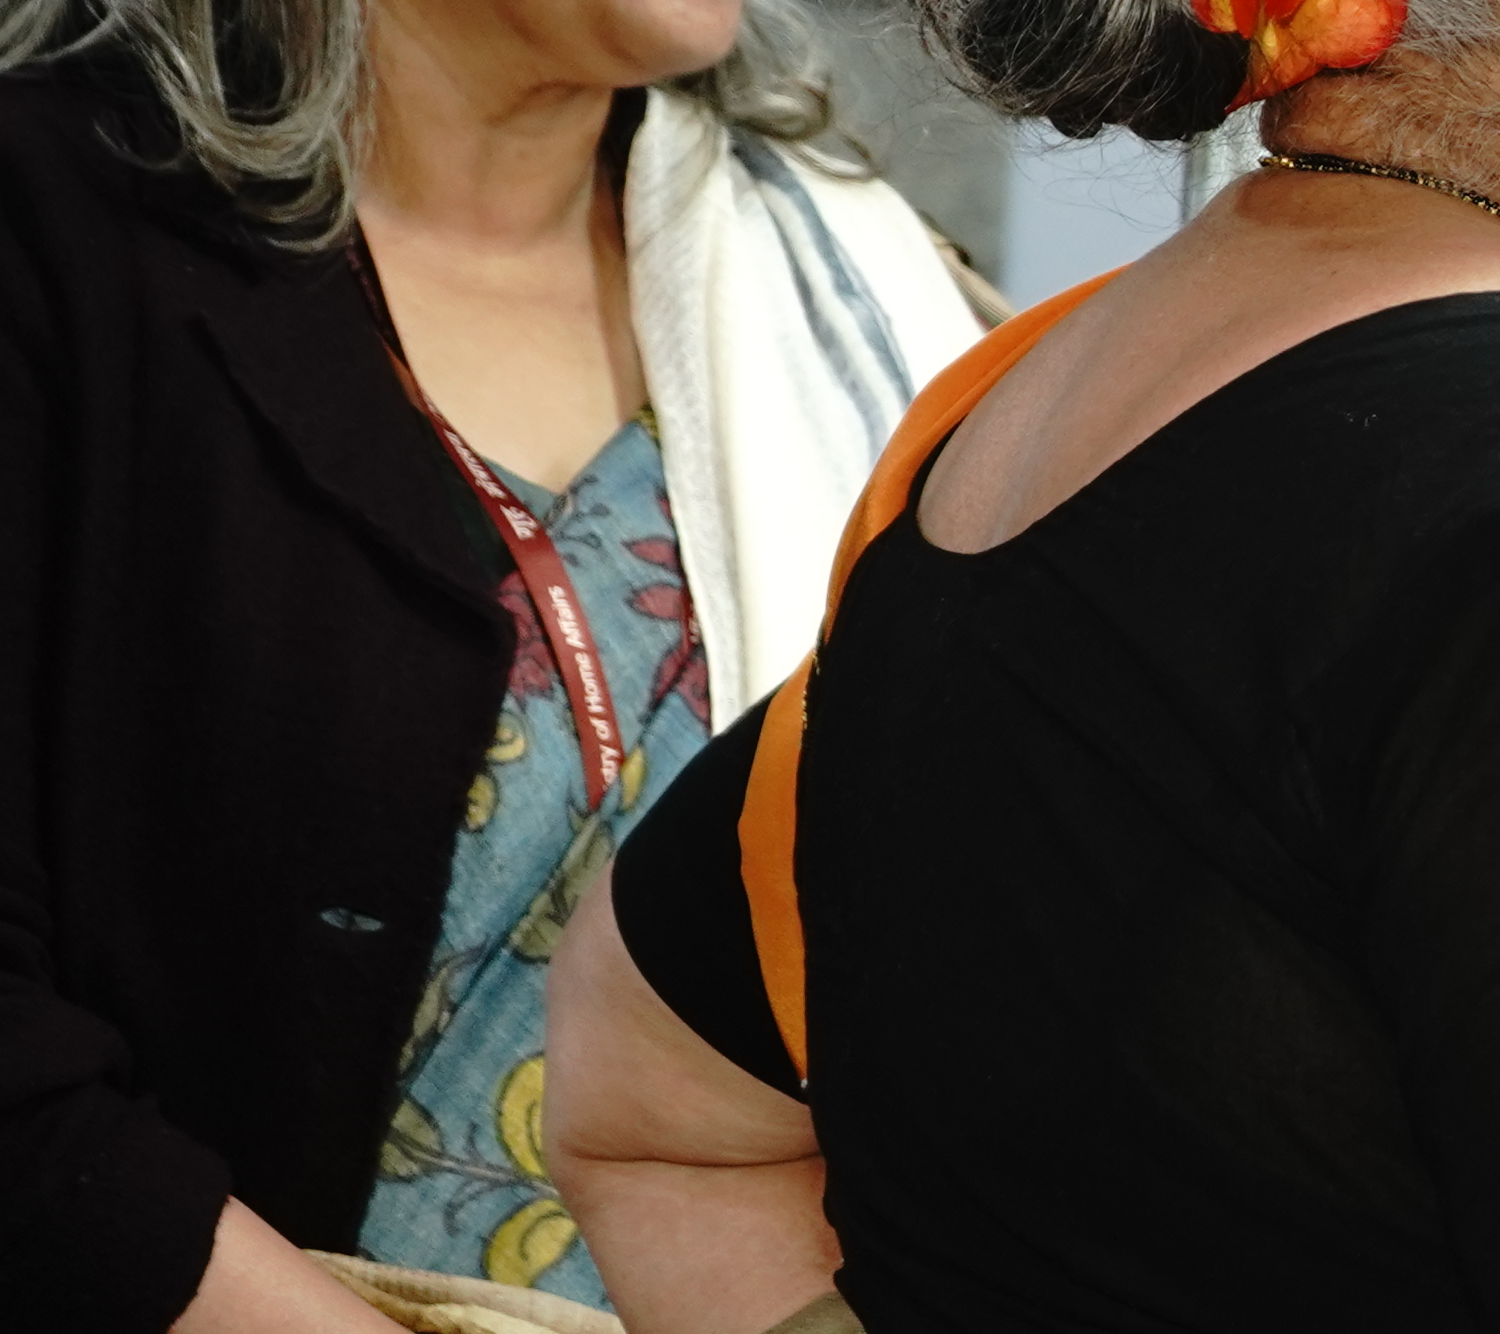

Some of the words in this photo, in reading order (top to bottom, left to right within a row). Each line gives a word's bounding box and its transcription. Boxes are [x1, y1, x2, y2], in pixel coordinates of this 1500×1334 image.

[548, 585, 586, 650] Affairs
[574, 651, 605, 714] Home
[589, 716, 611, 741] of
